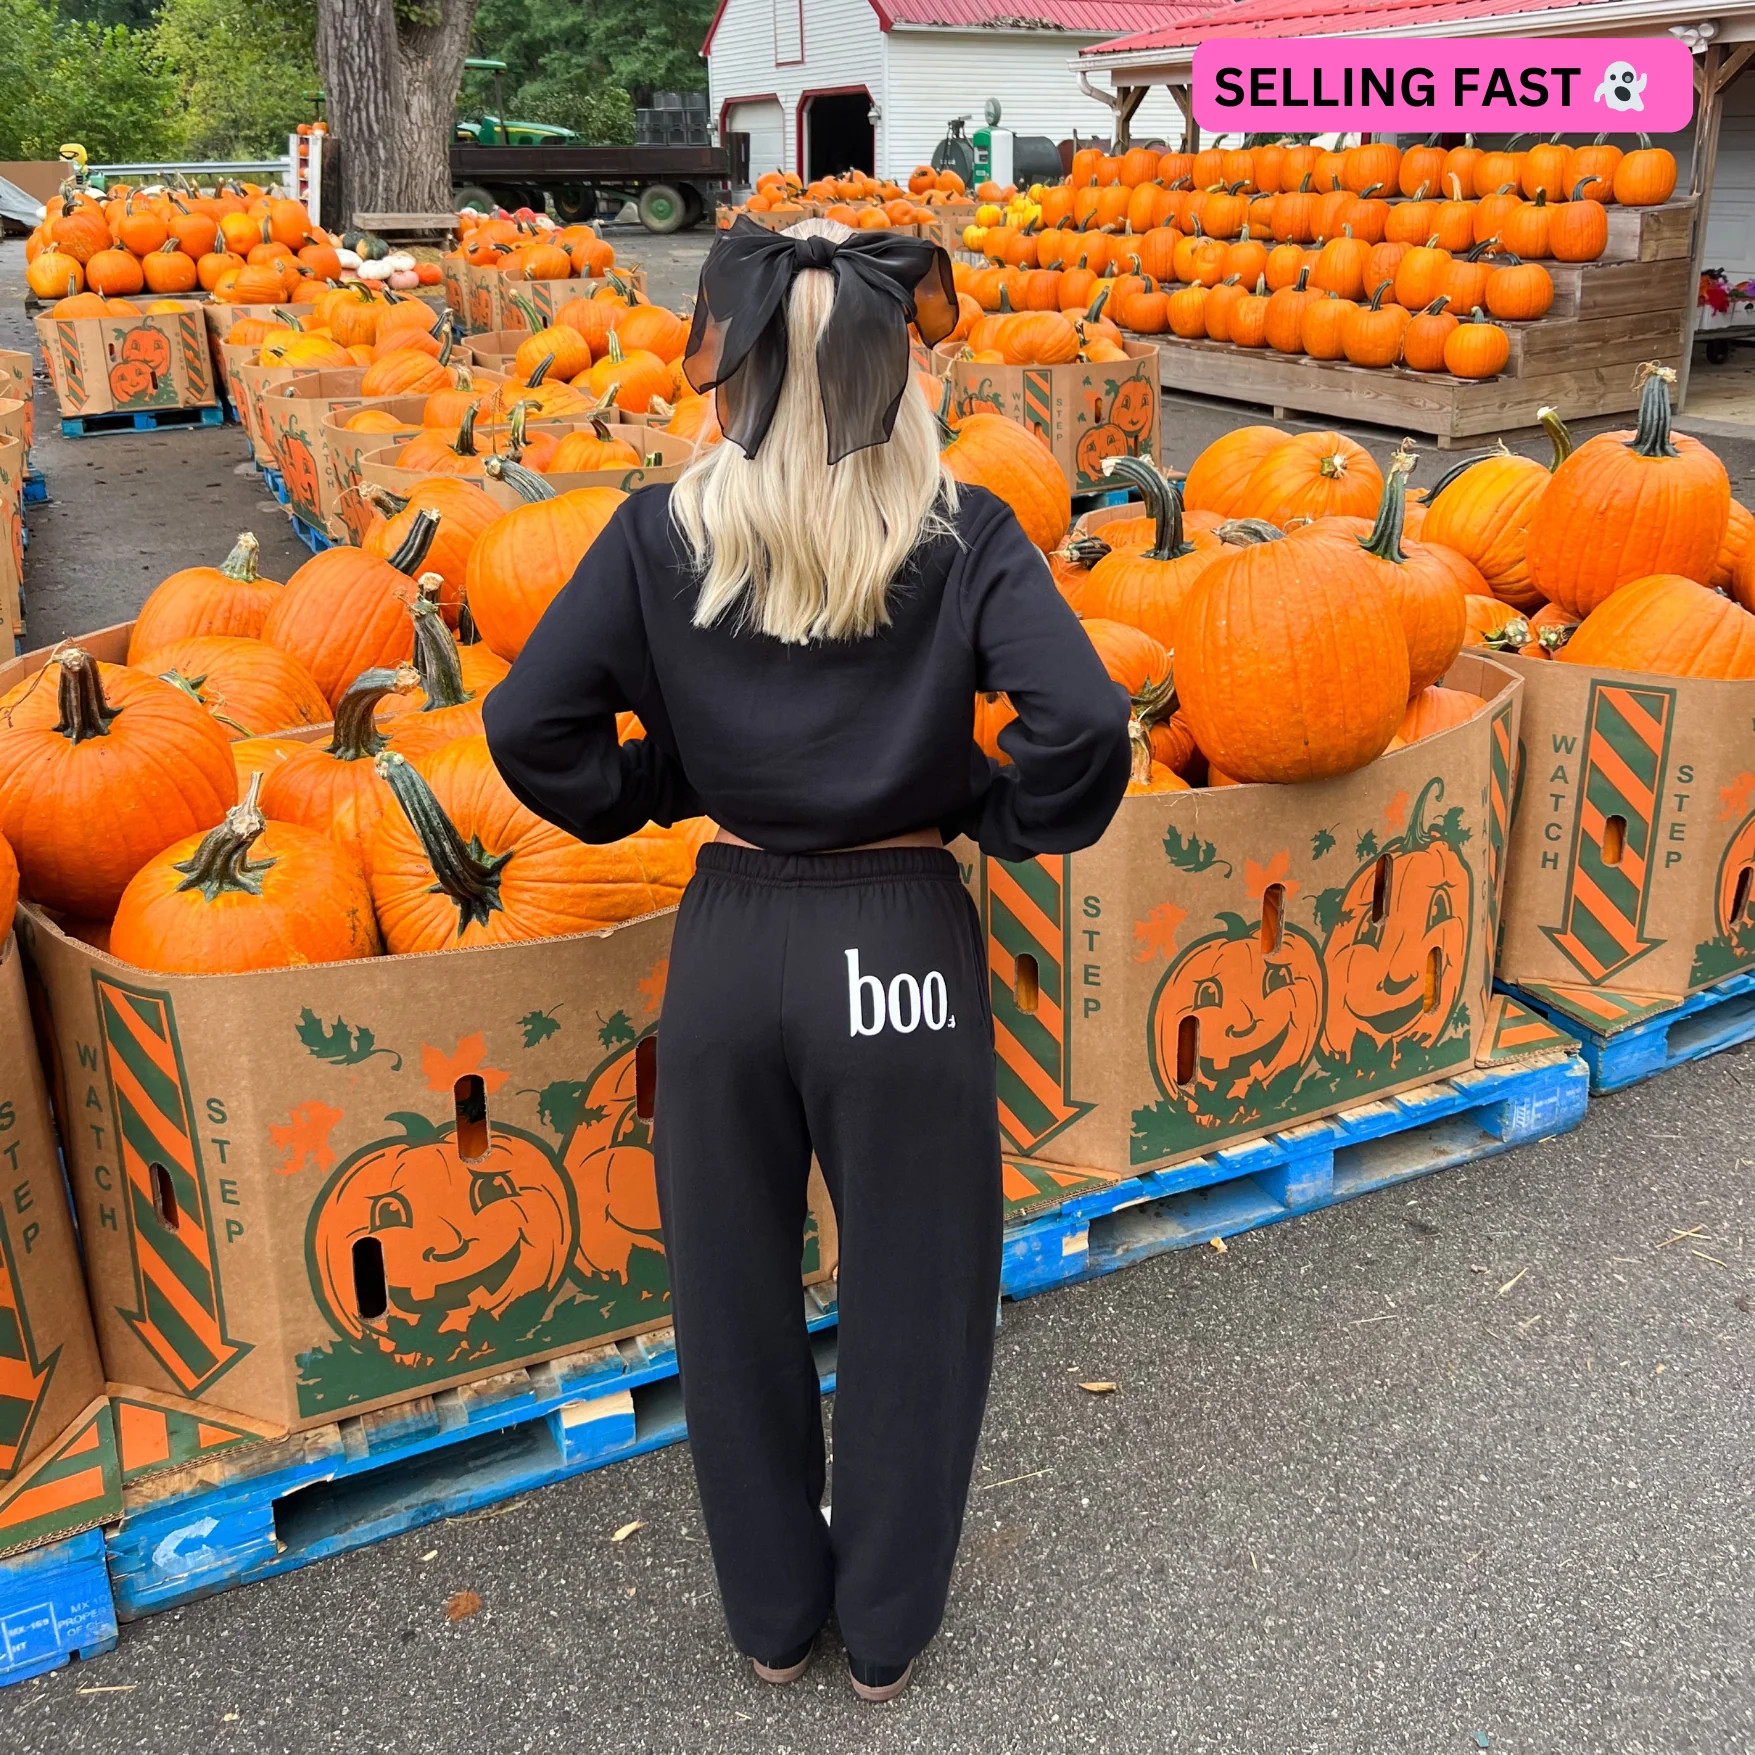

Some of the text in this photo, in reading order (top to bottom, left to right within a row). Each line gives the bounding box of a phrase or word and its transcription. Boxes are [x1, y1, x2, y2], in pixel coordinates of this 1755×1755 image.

[1012, 391, 1021, 423] WAT
[1541, 734, 1577, 870] WATCH
[1665, 765, 1694, 869] STEP
[1082, 895, 1101, 1019] STEP
[0, 1101, 40, 1255] STEP
[76, 1041, 118, 1232] WATCH
[206, 1098, 244, 1244] STEP
